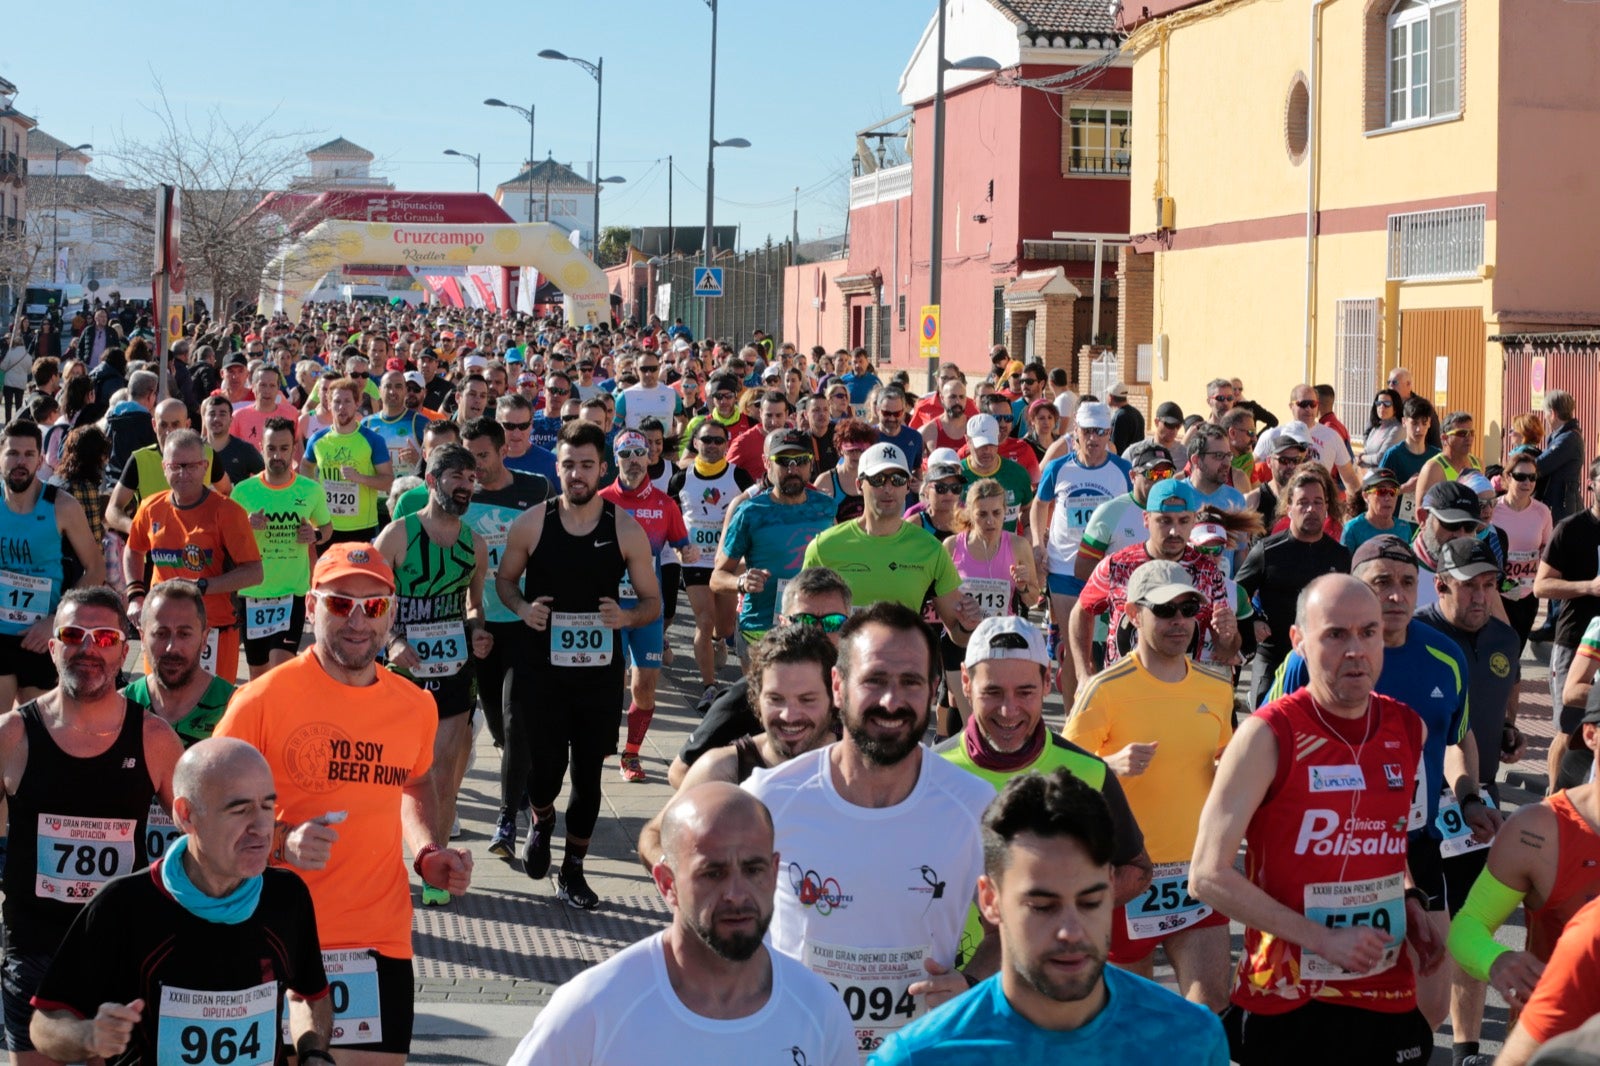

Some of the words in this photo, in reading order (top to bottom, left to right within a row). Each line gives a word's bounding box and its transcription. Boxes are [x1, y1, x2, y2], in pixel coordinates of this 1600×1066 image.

[391, 200, 445, 210] Diputación
[391, 212, 402, 221] de
[404, 212, 444, 222] Granada
[393, 229, 484, 246] Cruzcampo
[402, 248, 446, 262] Radler
[326, 492, 355, 505] 3120
[636, 509, 663, 519] SEUR
[696, 530, 721, 544] 800
[9, 590, 34, 608] 17
[255, 607, 286, 625] 873
[562, 630, 603, 649] 930
[417, 639, 458, 660] 943
[330, 739, 350, 760] YO
[355, 742, 384, 763] SOY
[328, 761, 370, 783] BEER
[63, 819, 79, 828] GRAN
[81, 820, 102, 830] PREMIO
[104, 822, 112, 830] DE
[54, 843, 119, 876] 780
[1142, 880, 1200, 912] 252
[340, 952, 348, 961] DE
[836, 950, 856, 962] GRAN
[858, 953, 887, 963] PREMIO
[889, 953, 897, 963] DE
[900, 950, 923, 961] FONDO
[169, 990, 190, 1004] XXXIII
[192, 994, 213, 1005] GRAN
[216, 996, 243, 1005] PREMIO
[245, 992, 251, 1003] DE
[253, 986, 272, 1000] FONDO
[829, 982, 916, 1021] 094
[181, 1021, 260, 1065] 964
